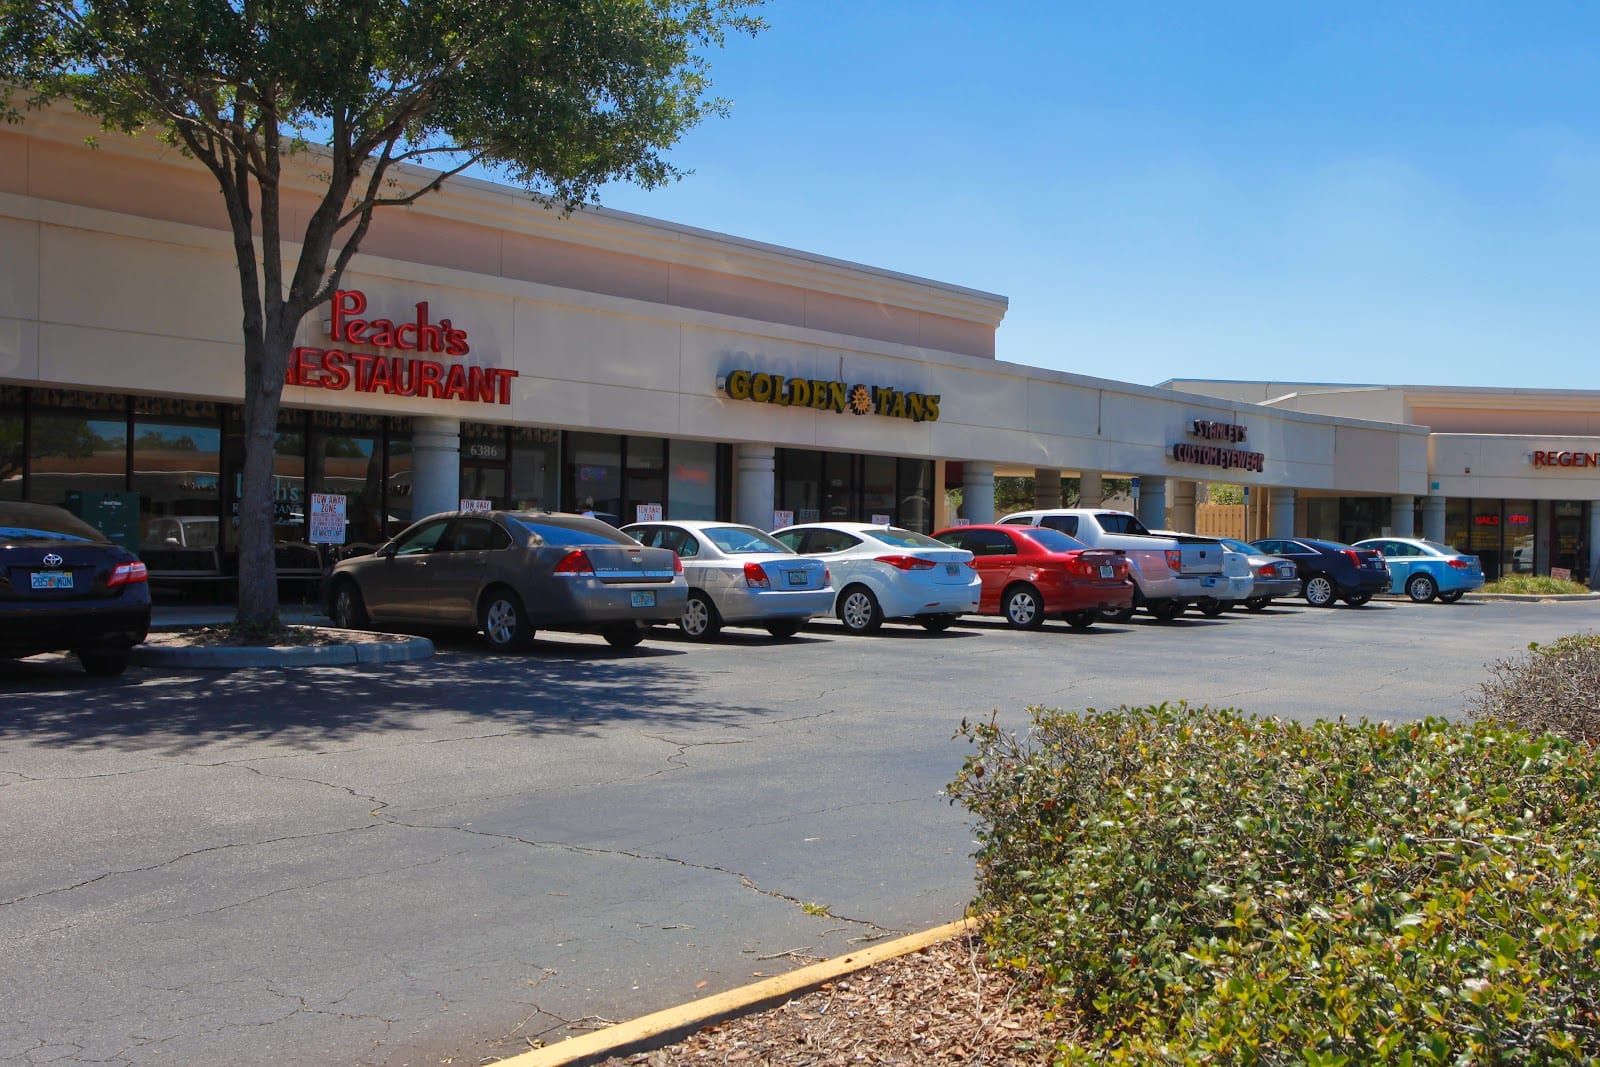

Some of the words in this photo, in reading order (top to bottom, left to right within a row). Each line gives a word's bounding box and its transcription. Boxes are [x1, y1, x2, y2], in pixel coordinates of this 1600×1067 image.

[330, 289, 470, 356] Peach's
[725, 369, 848, 414] GOLDEN
[872, 385, 941, 422] TANS
[470, 444, 498, 457] 6386
[1173, 443, 1219, 466] CUSTOM
[1220, 448, 1265, 473] EYEWEAR
[312, 494, 328, 504] TOW
[320, 504, 337, 513] ZONE
[1475, 515, 1499, 526] NAILS
